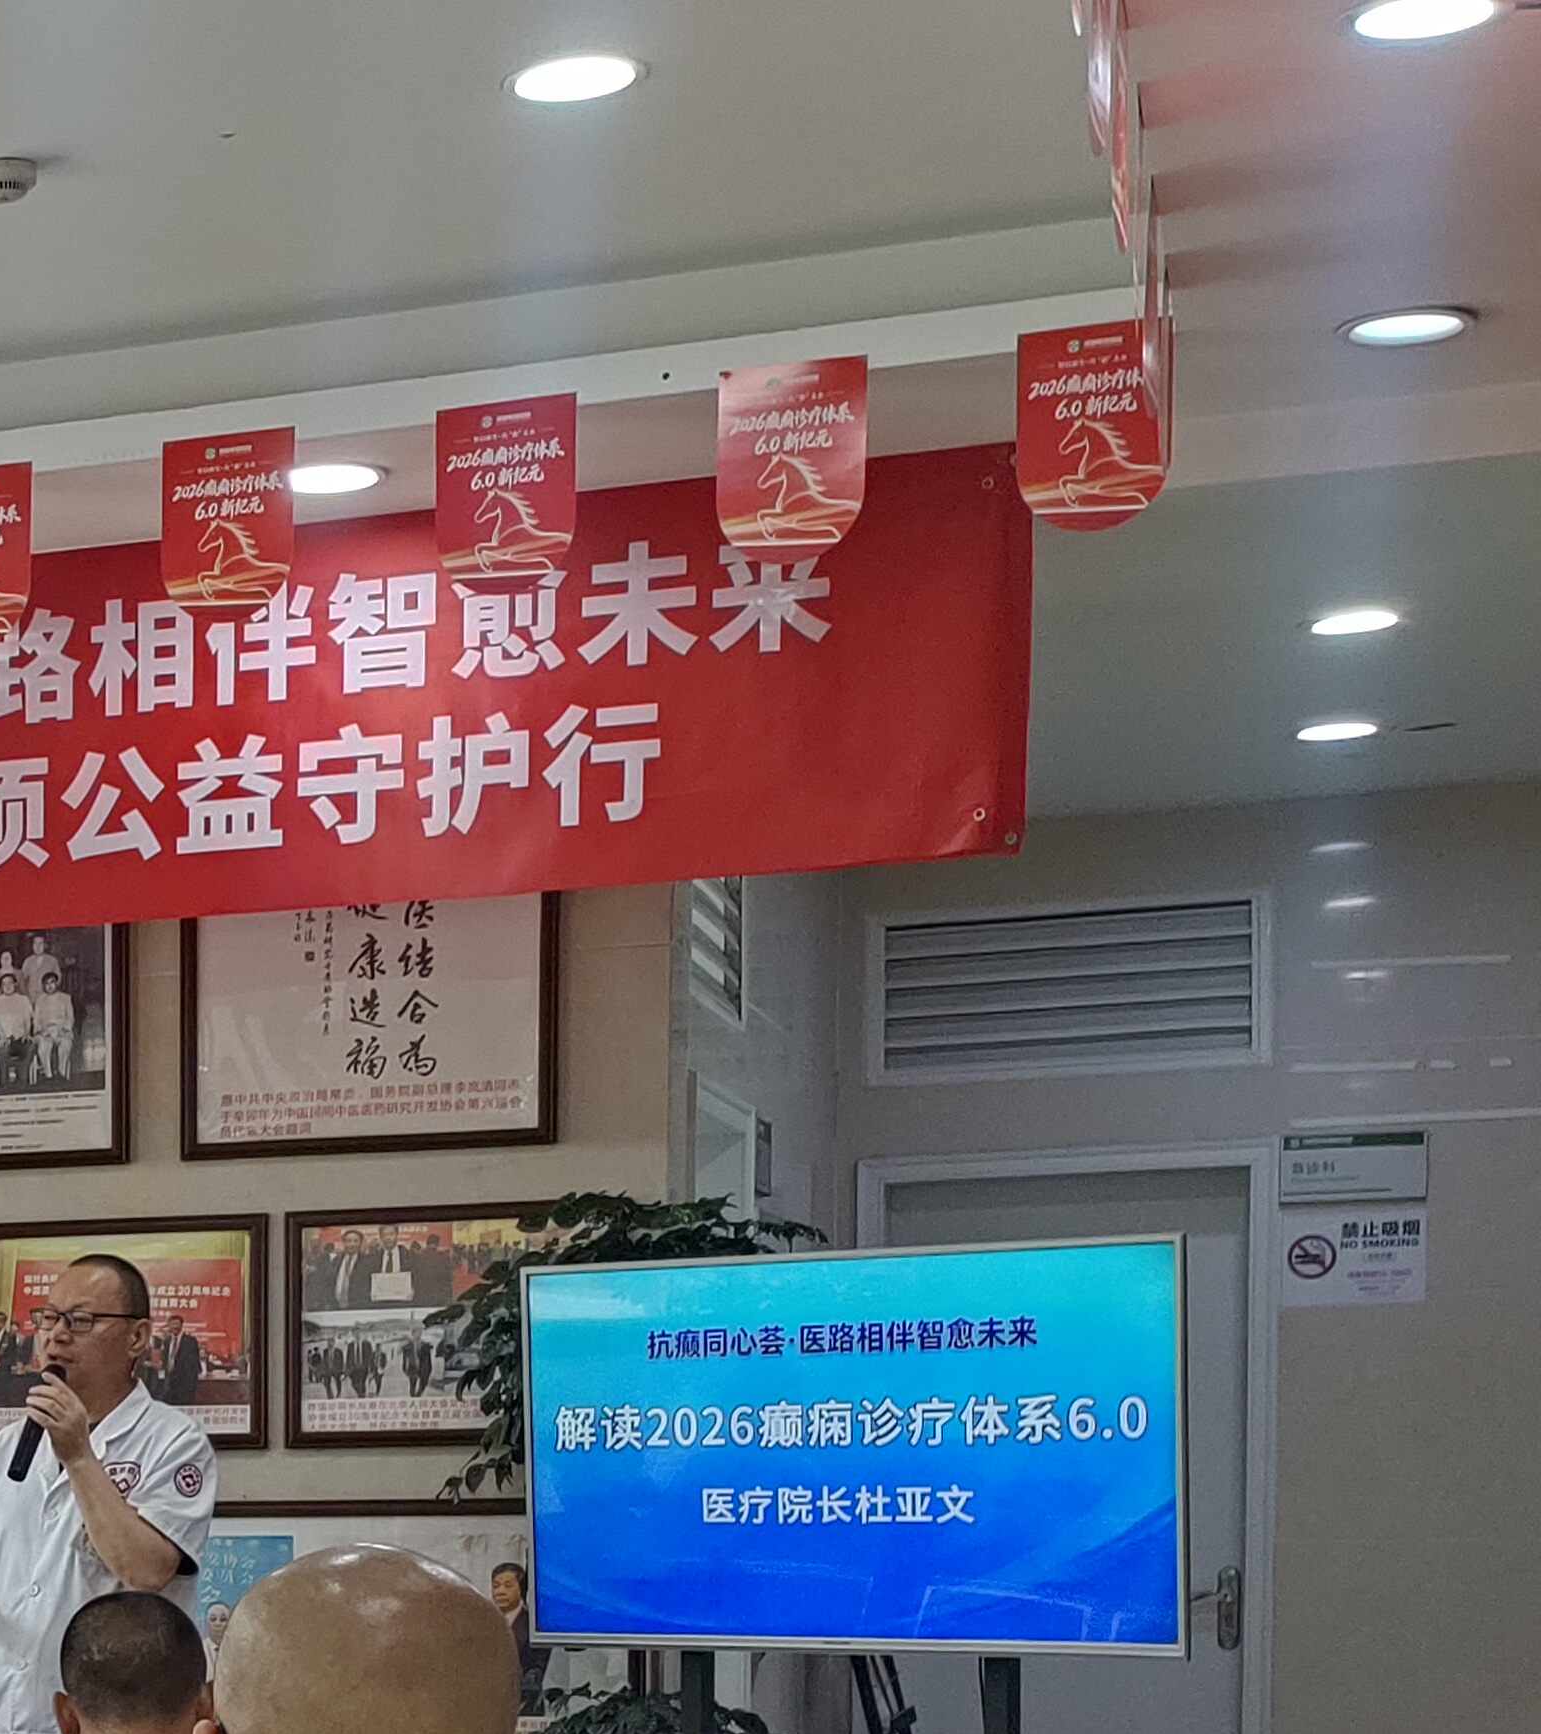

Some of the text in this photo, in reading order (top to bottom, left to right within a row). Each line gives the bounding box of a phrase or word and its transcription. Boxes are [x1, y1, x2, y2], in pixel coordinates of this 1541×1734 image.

[1027, 366, 1144, 400] 2026癫痫诊疗体
[1054, 398, 1082, 420] 6.0
[753, 433, 780, 457] 6.0
[470, 471, 495, 491] 6.0
[194, 501, 218, 521] 6.0
[1341, 1219, 1421, 1239] 禁止吸烟
[1340, 1238, 1419, 1249] NO SMOKING
[647, 1315, 1038, 1360] 抗癫同心荟·医路相伴智愈未来
[555, 1394, 1149, 1452] 解读2026癫痫诊疗体系6.0
[702, 1484, 975, 1525] 医疗院长杜亚文
